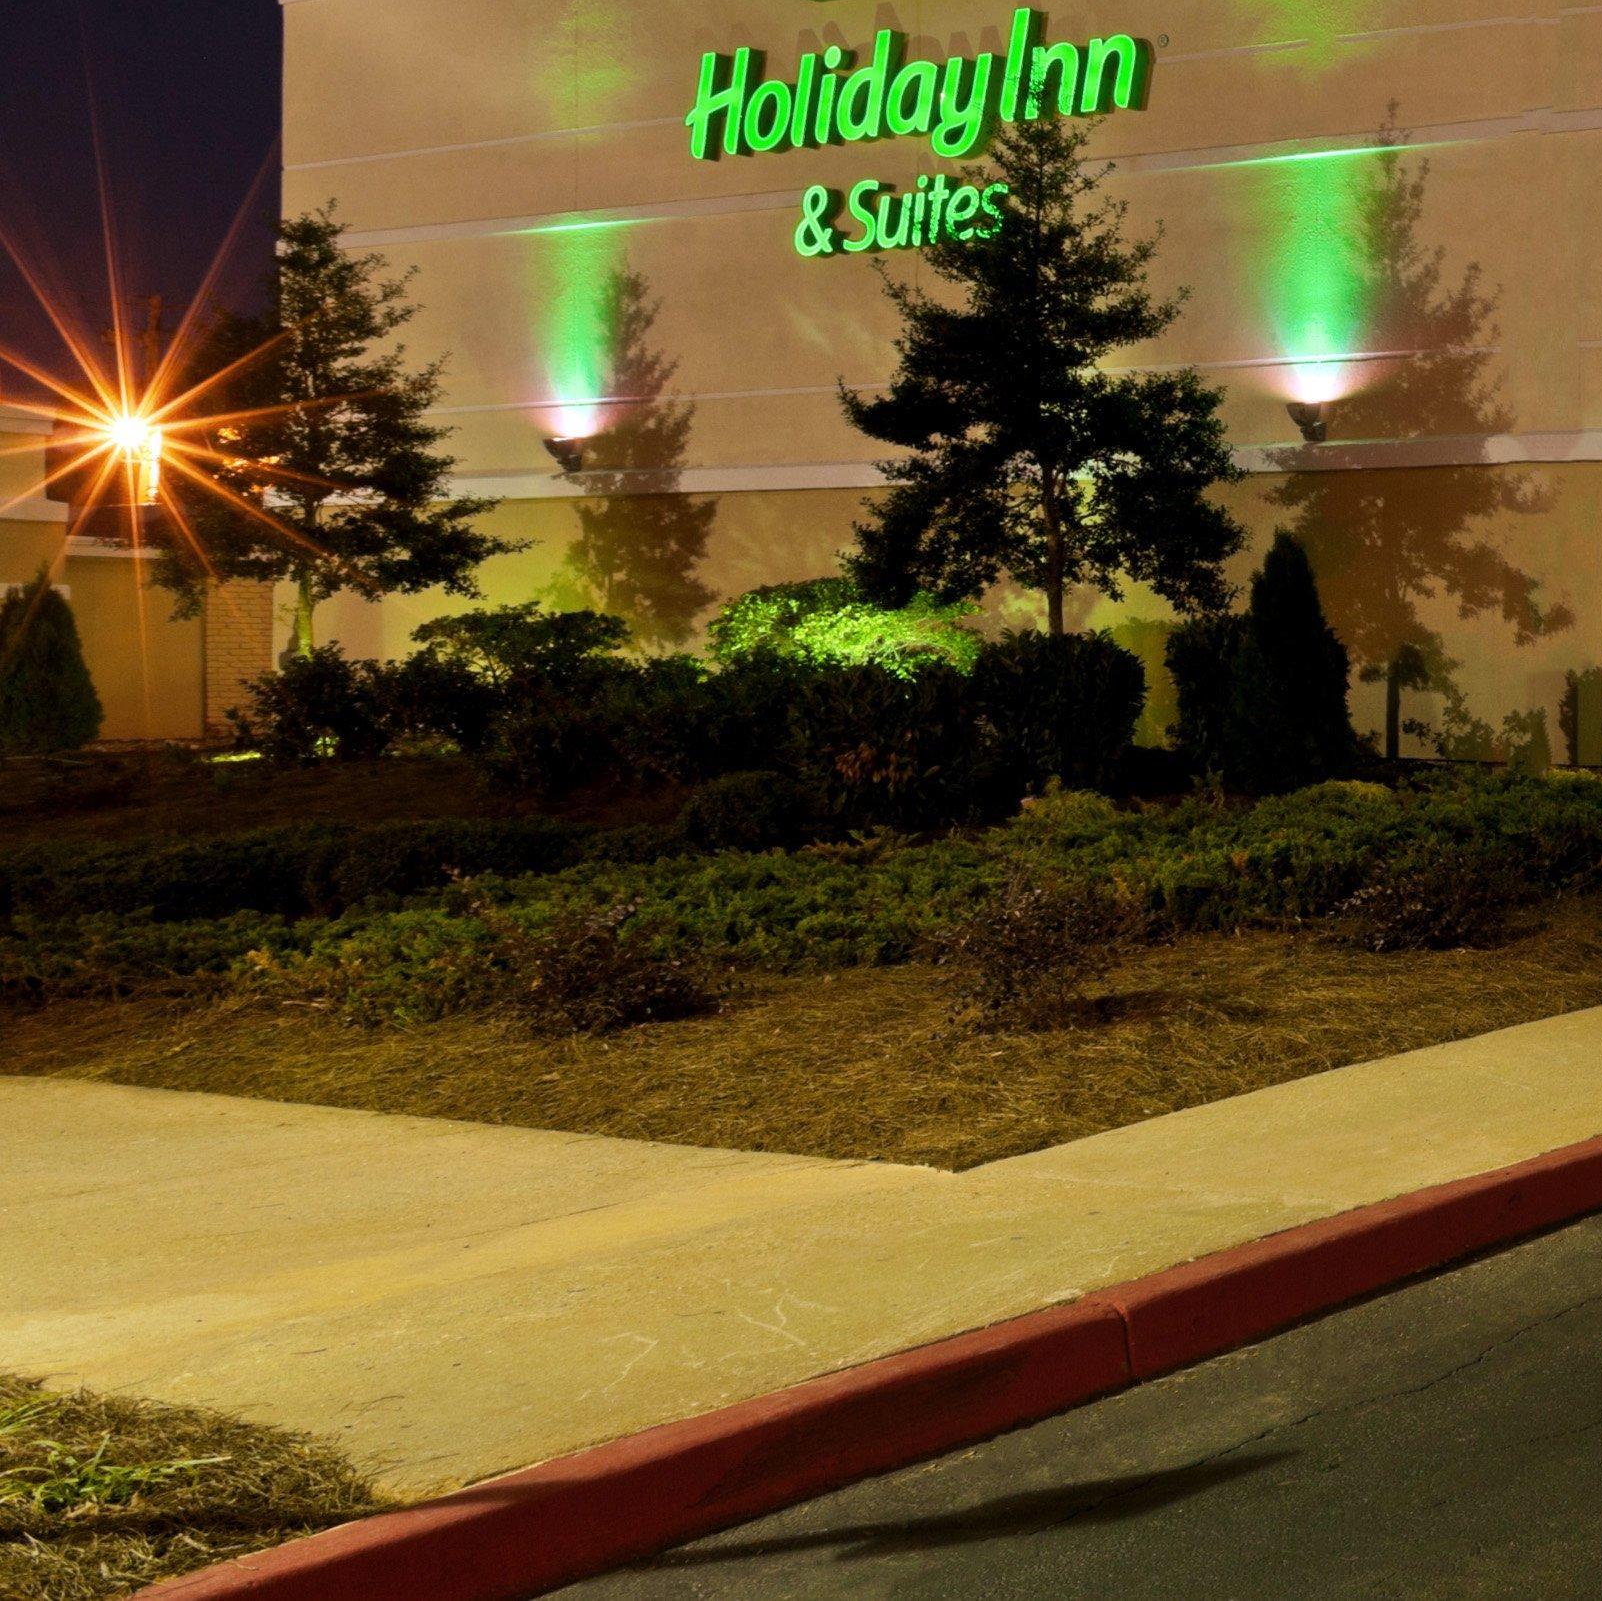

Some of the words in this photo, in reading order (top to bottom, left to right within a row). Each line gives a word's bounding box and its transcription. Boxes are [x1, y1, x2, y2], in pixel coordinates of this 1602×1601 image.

[685, 29, 993, 160] Holiday
[1000, 7, 1137, 123] Inn
[794, 184, 833, 257] &
[842, 173, 1009, 252] Suites
